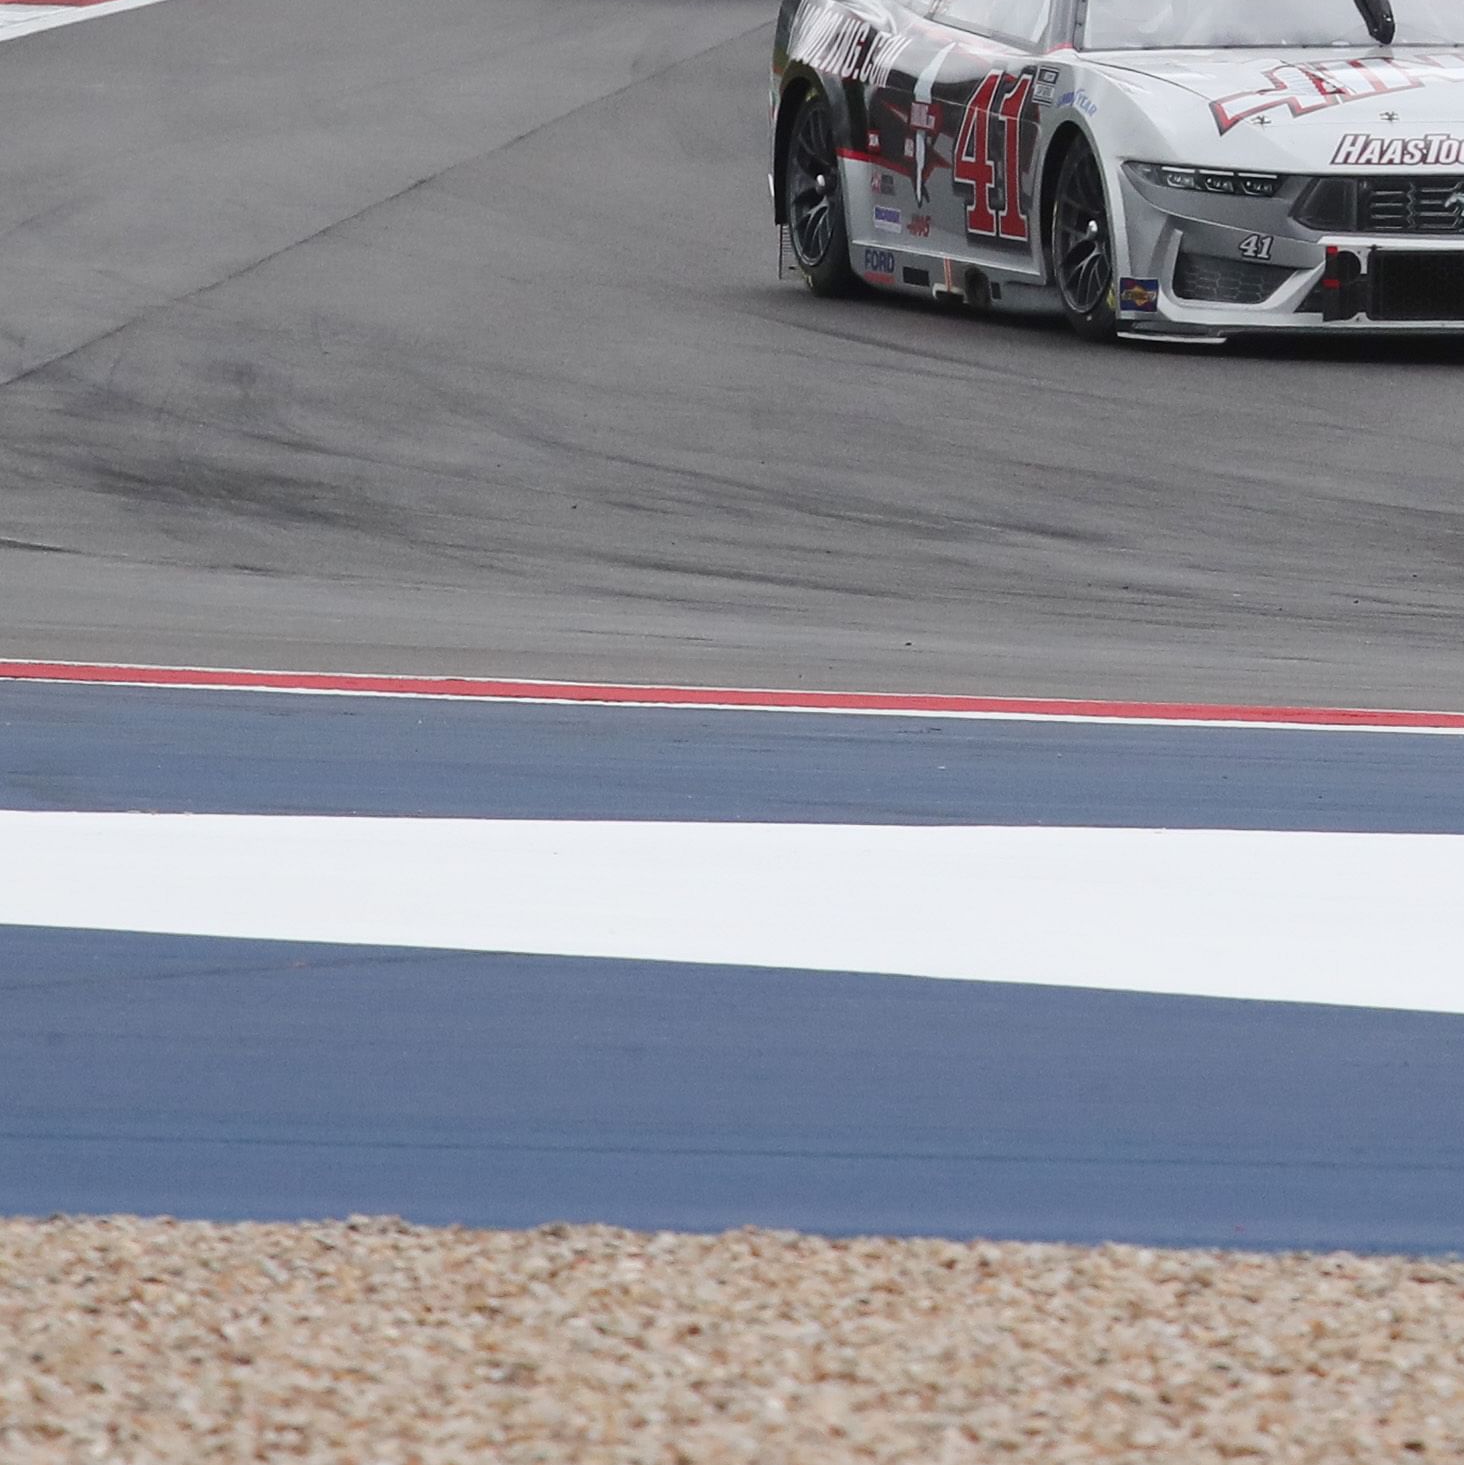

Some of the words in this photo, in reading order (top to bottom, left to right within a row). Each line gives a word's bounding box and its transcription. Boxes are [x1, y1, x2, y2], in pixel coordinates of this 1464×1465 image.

[953, 69, 1034, 242] 41
[1239, 233, 1274, 260] 41
[864, 247, 896, 274] FORD
